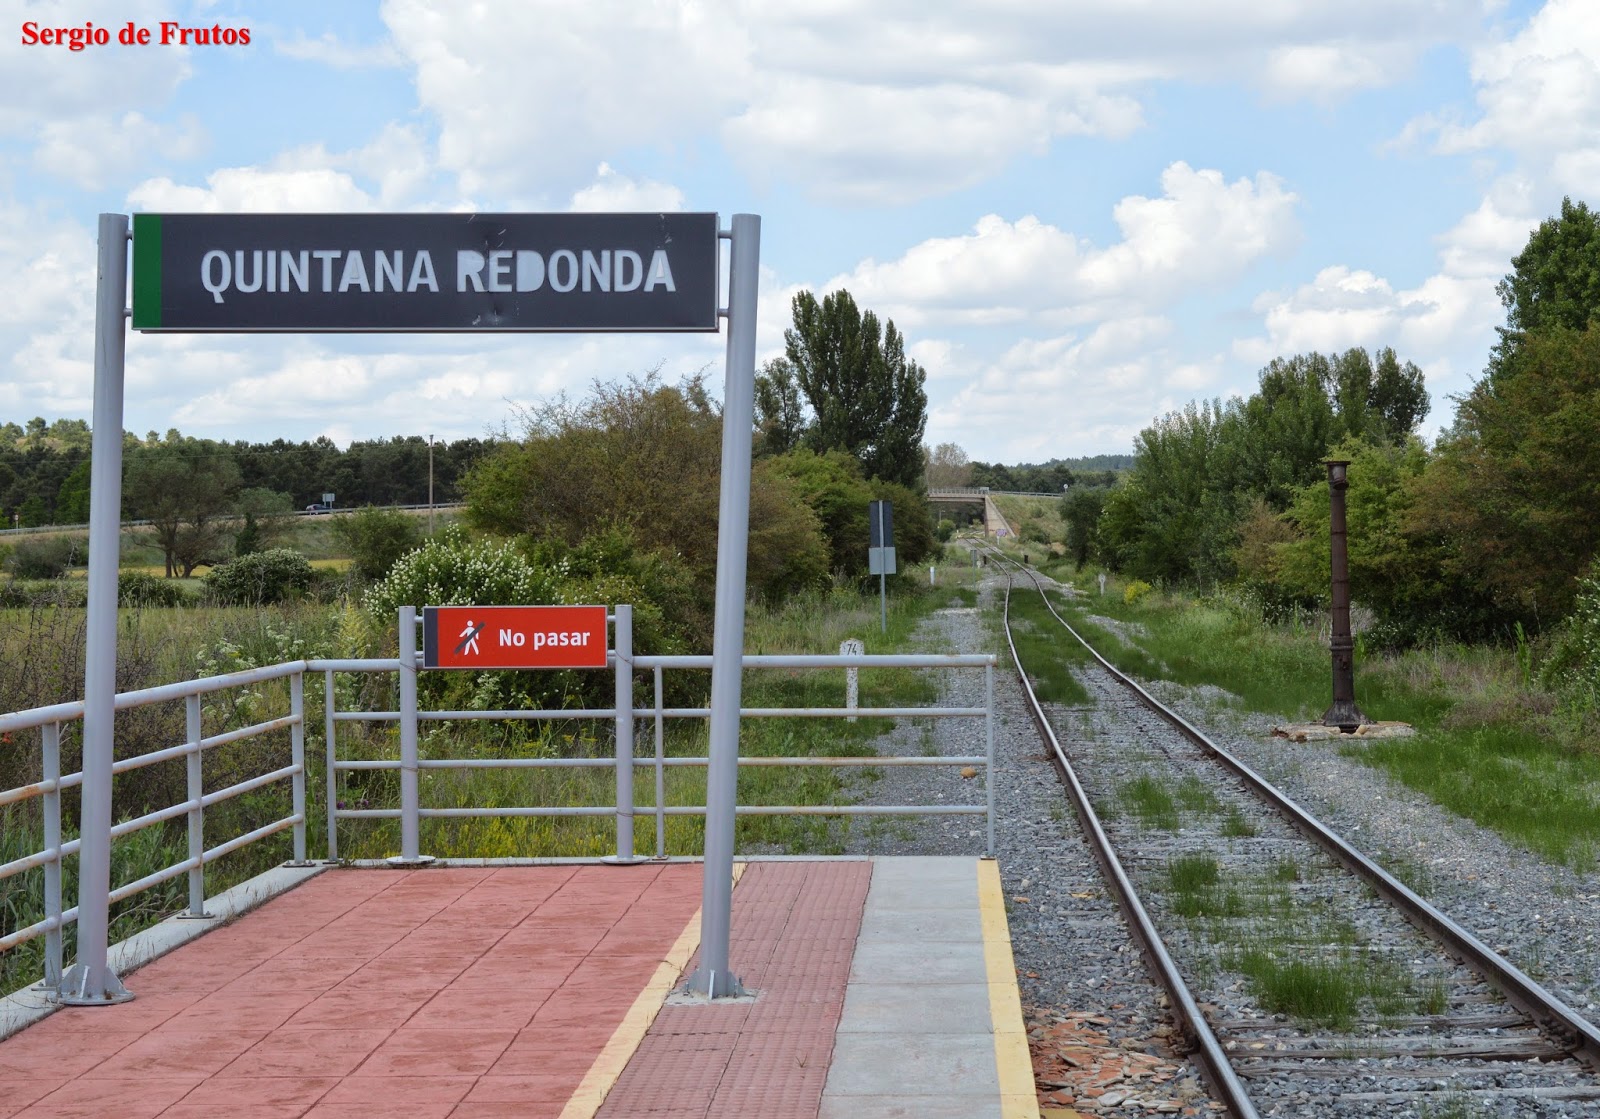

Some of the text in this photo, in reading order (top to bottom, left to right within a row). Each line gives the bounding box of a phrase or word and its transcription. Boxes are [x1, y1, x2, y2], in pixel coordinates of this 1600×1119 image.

[201, 250, 676, 304] QUINTANA REDONDA
[499, 629, 591, 651] No pasar
[847, 643, 857, 656] 74
